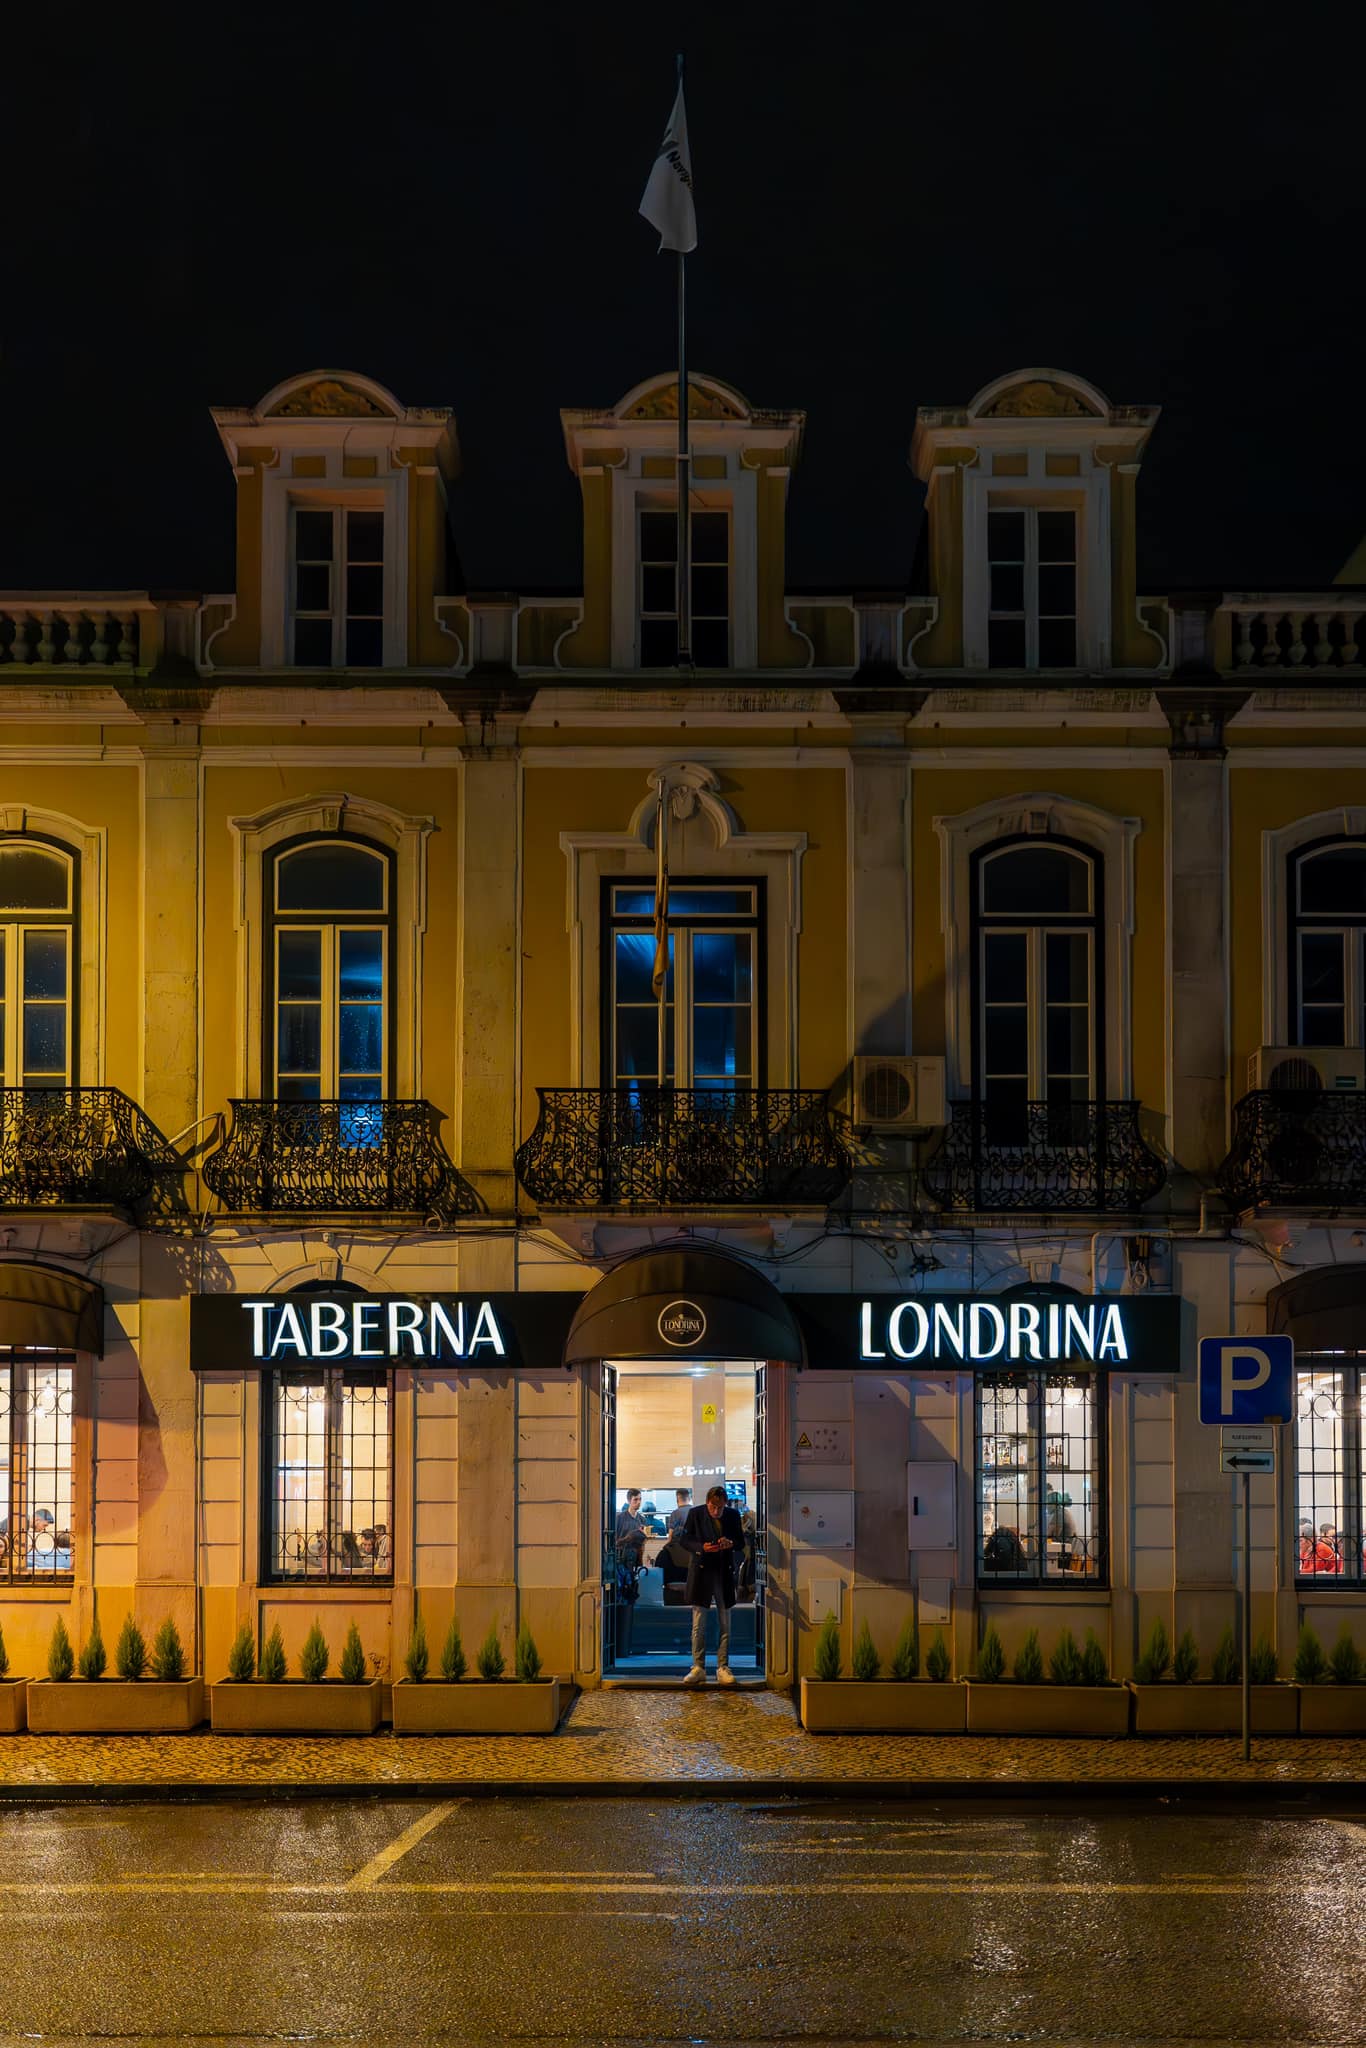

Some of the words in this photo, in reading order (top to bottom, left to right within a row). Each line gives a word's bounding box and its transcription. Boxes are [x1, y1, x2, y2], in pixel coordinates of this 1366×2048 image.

[241, 1301, 505, 1357] TABERNA
[861, 1301, 1129, 1360] LONDRINA
[1220, 1346, 1272, 1416] P
